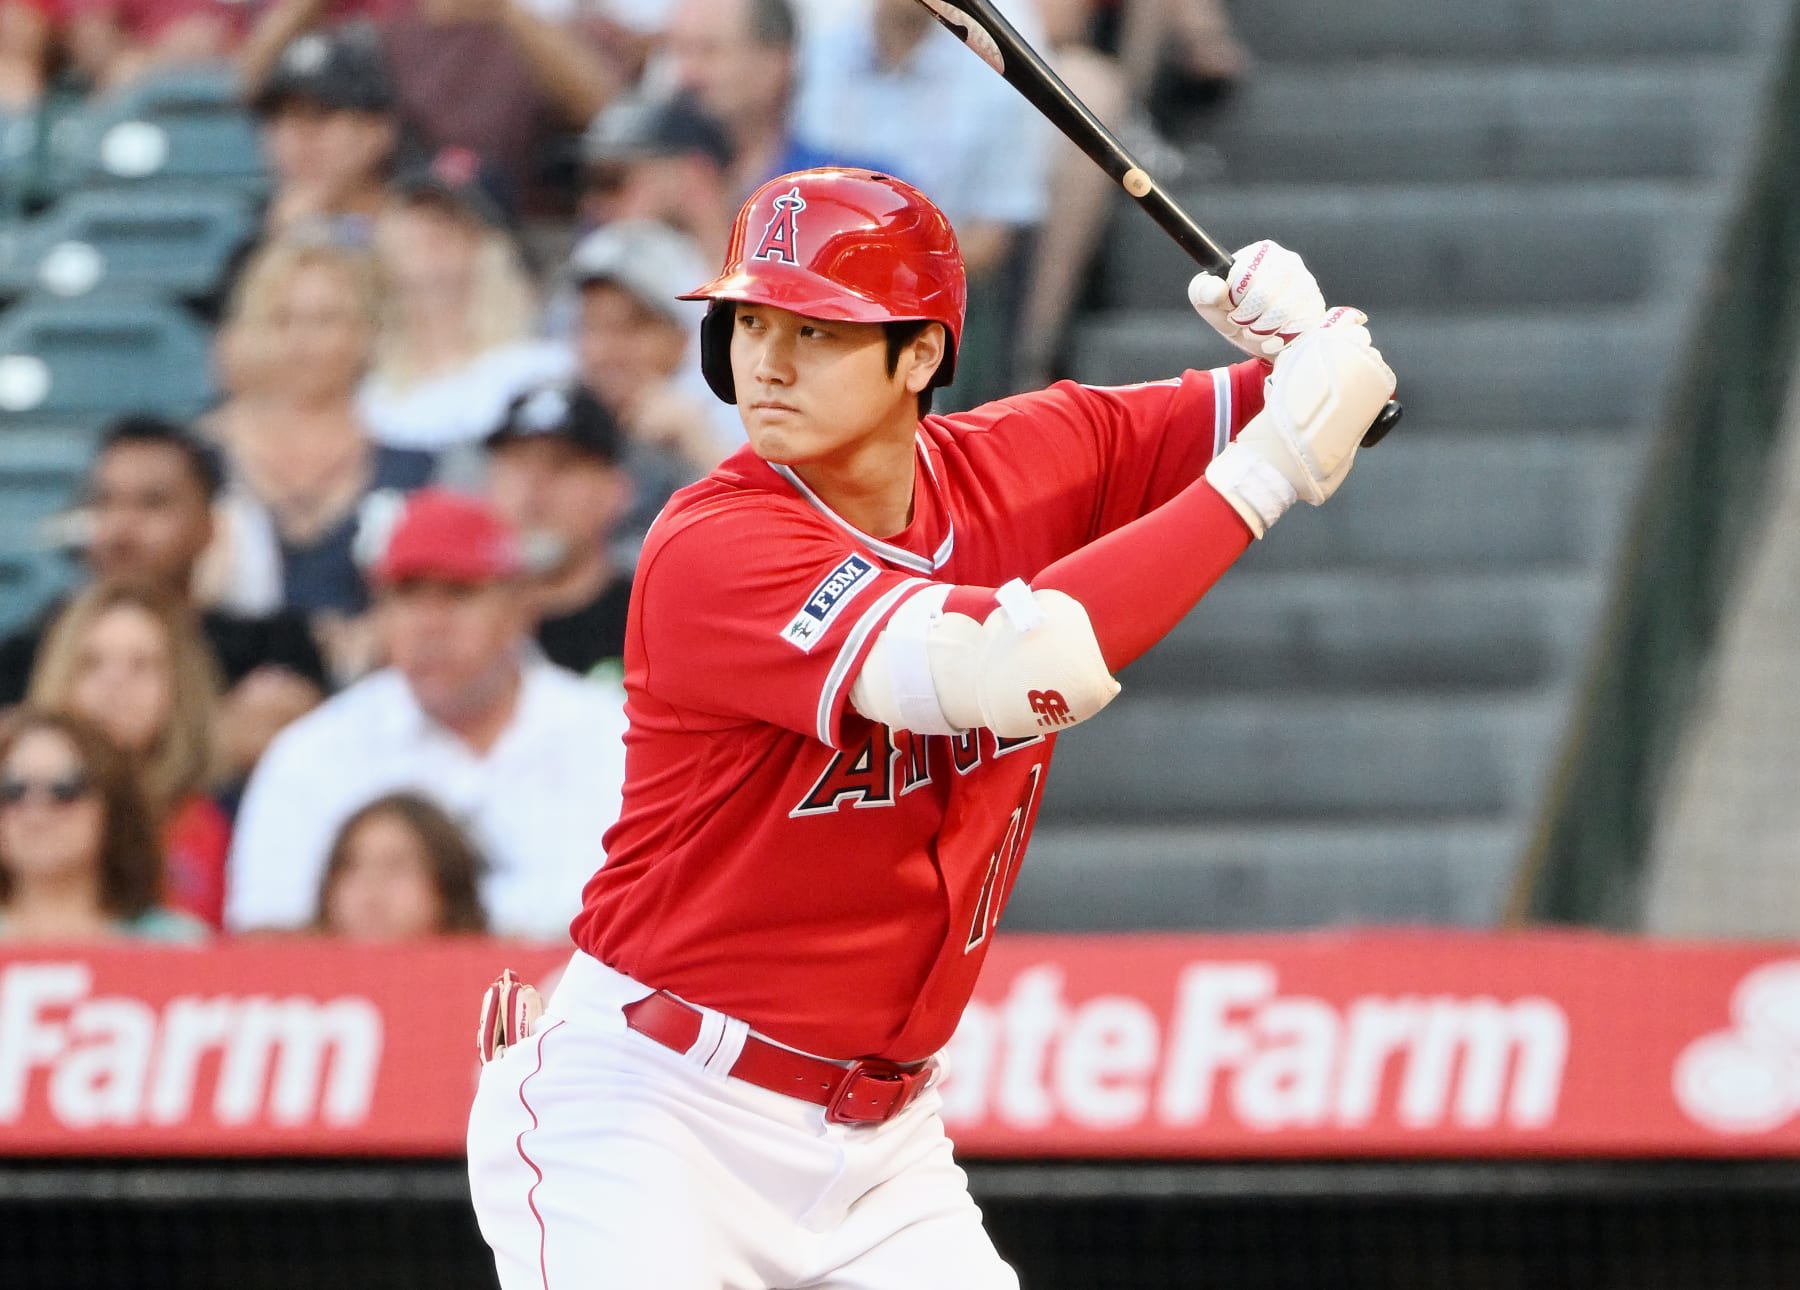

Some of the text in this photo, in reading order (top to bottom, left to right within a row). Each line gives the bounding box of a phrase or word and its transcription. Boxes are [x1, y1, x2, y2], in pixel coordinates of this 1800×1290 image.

[751, 187, 807, 267] A
[1236, 272, 1252, 294] new
[811, 562, 864, 613] FBM
[0, 960, 383, 1130] Farm
